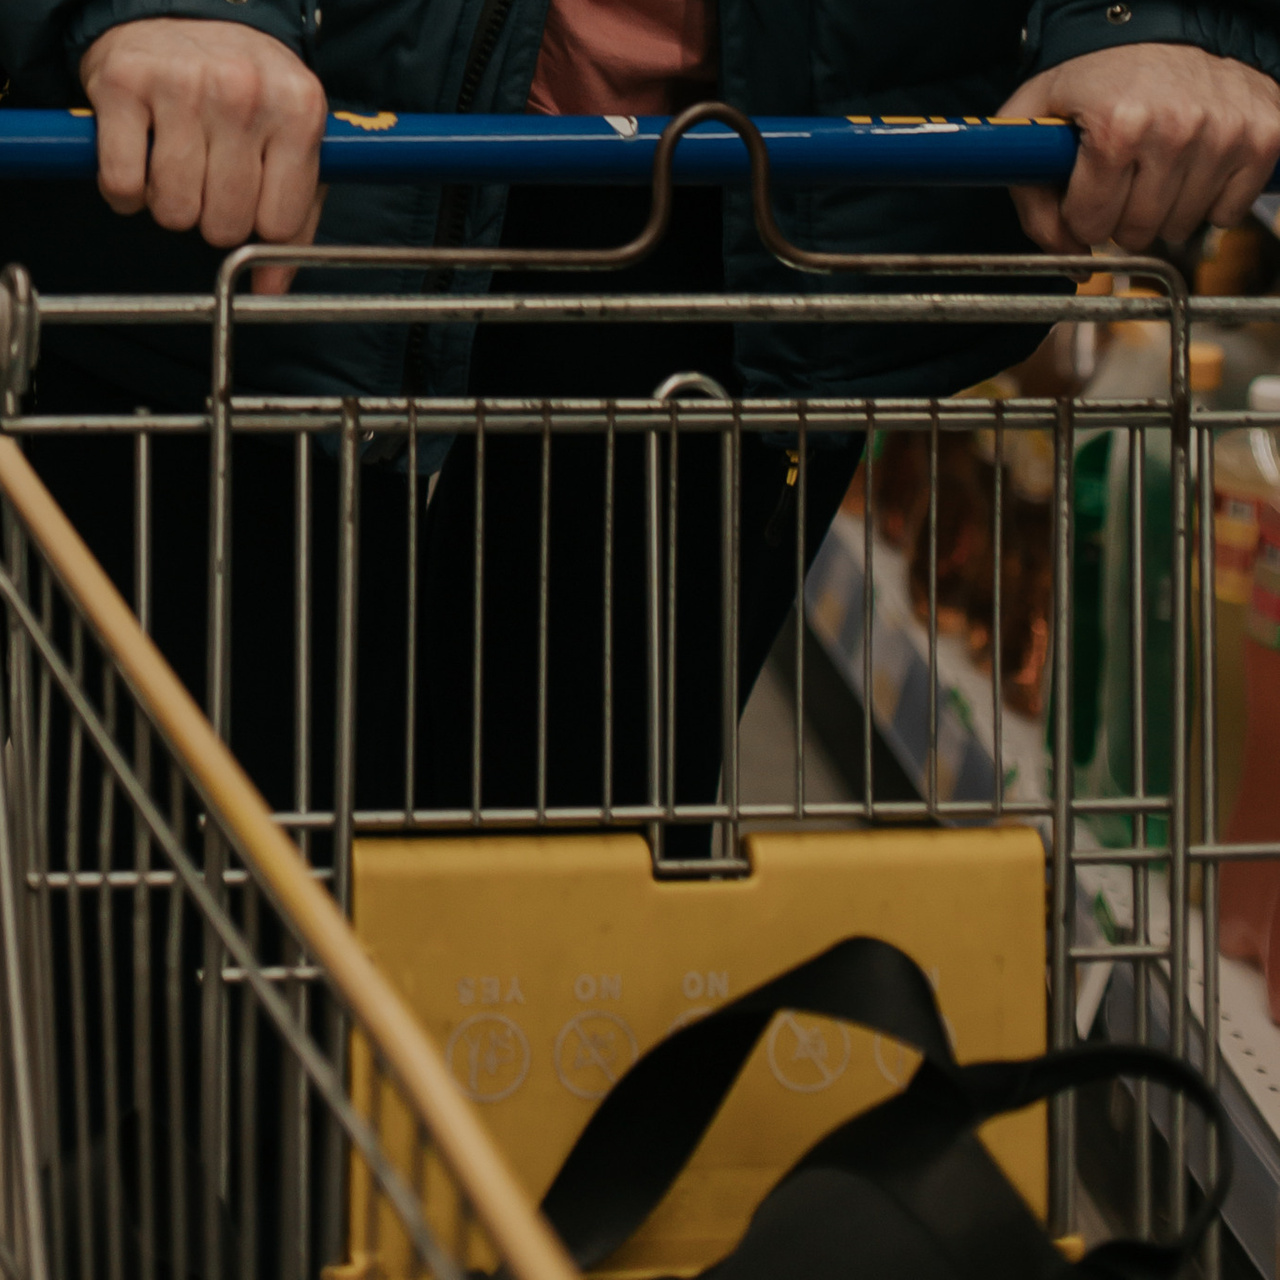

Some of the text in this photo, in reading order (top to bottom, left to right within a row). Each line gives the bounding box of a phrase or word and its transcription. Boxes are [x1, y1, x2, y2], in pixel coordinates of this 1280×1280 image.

[457, 976, 525, 1005] YES
[574, 973, 622, 1001] NO
[682, 970, 730, 999] NO
